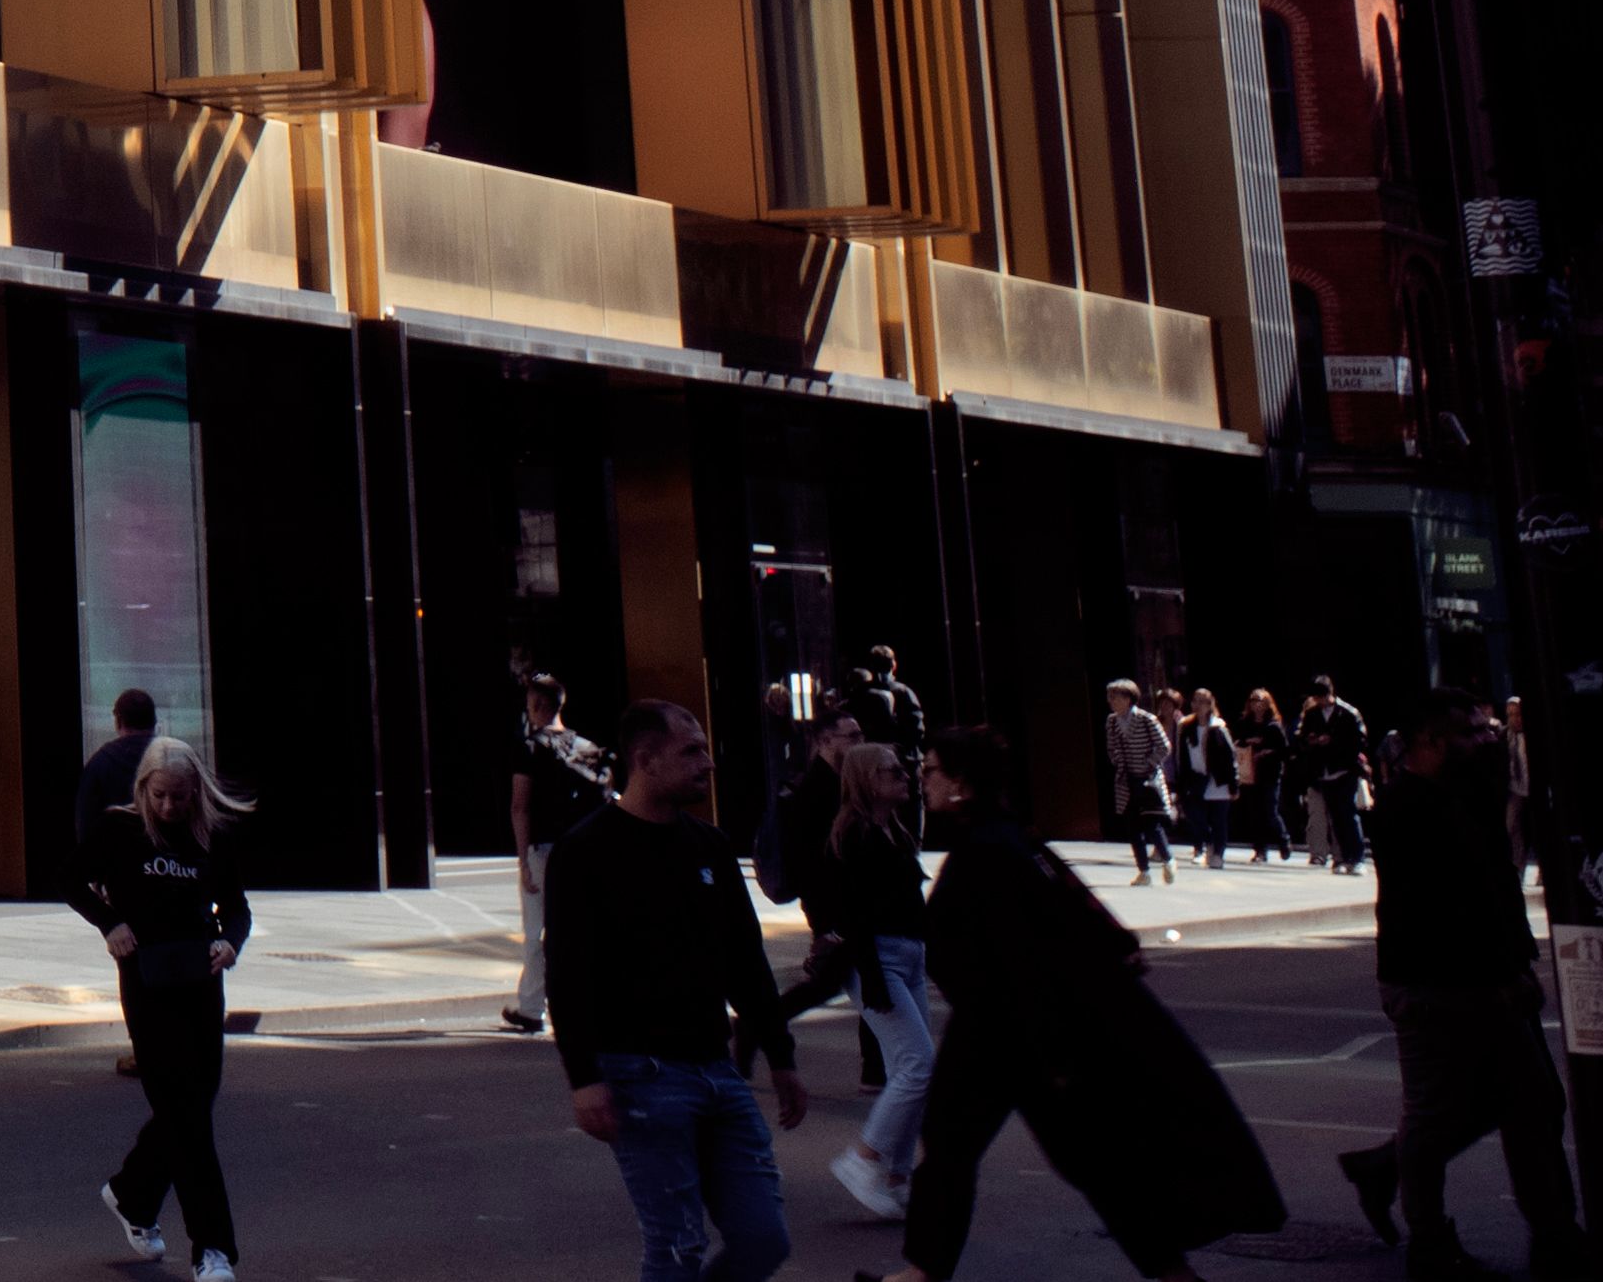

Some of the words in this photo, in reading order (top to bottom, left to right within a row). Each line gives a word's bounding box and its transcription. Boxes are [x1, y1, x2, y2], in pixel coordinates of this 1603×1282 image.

[1444, 553, 1482, 564] BLANK
[1443, 563, 1486, 574] STREET
[143, 856, 199, 880] s.Olive
